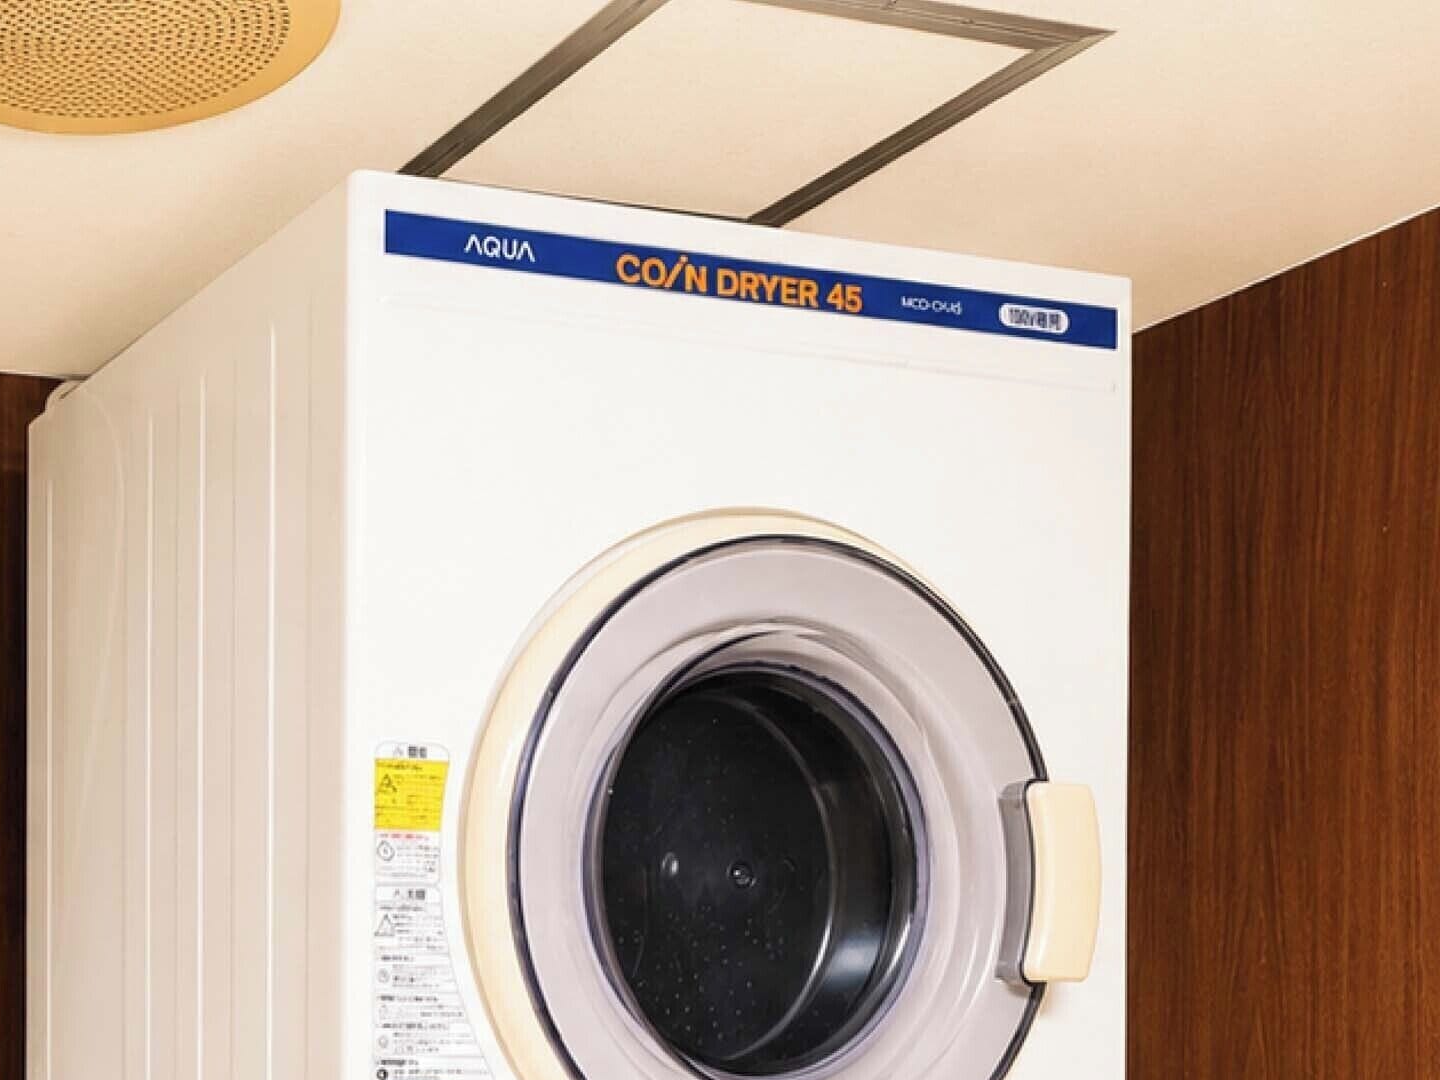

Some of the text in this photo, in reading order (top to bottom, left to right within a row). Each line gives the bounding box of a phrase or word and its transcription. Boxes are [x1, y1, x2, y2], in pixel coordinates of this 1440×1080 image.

[464, 233, 536, 263] AQUA
[716, 268, 820, 309] DRYER
[826, 282, 863, 313] 45
